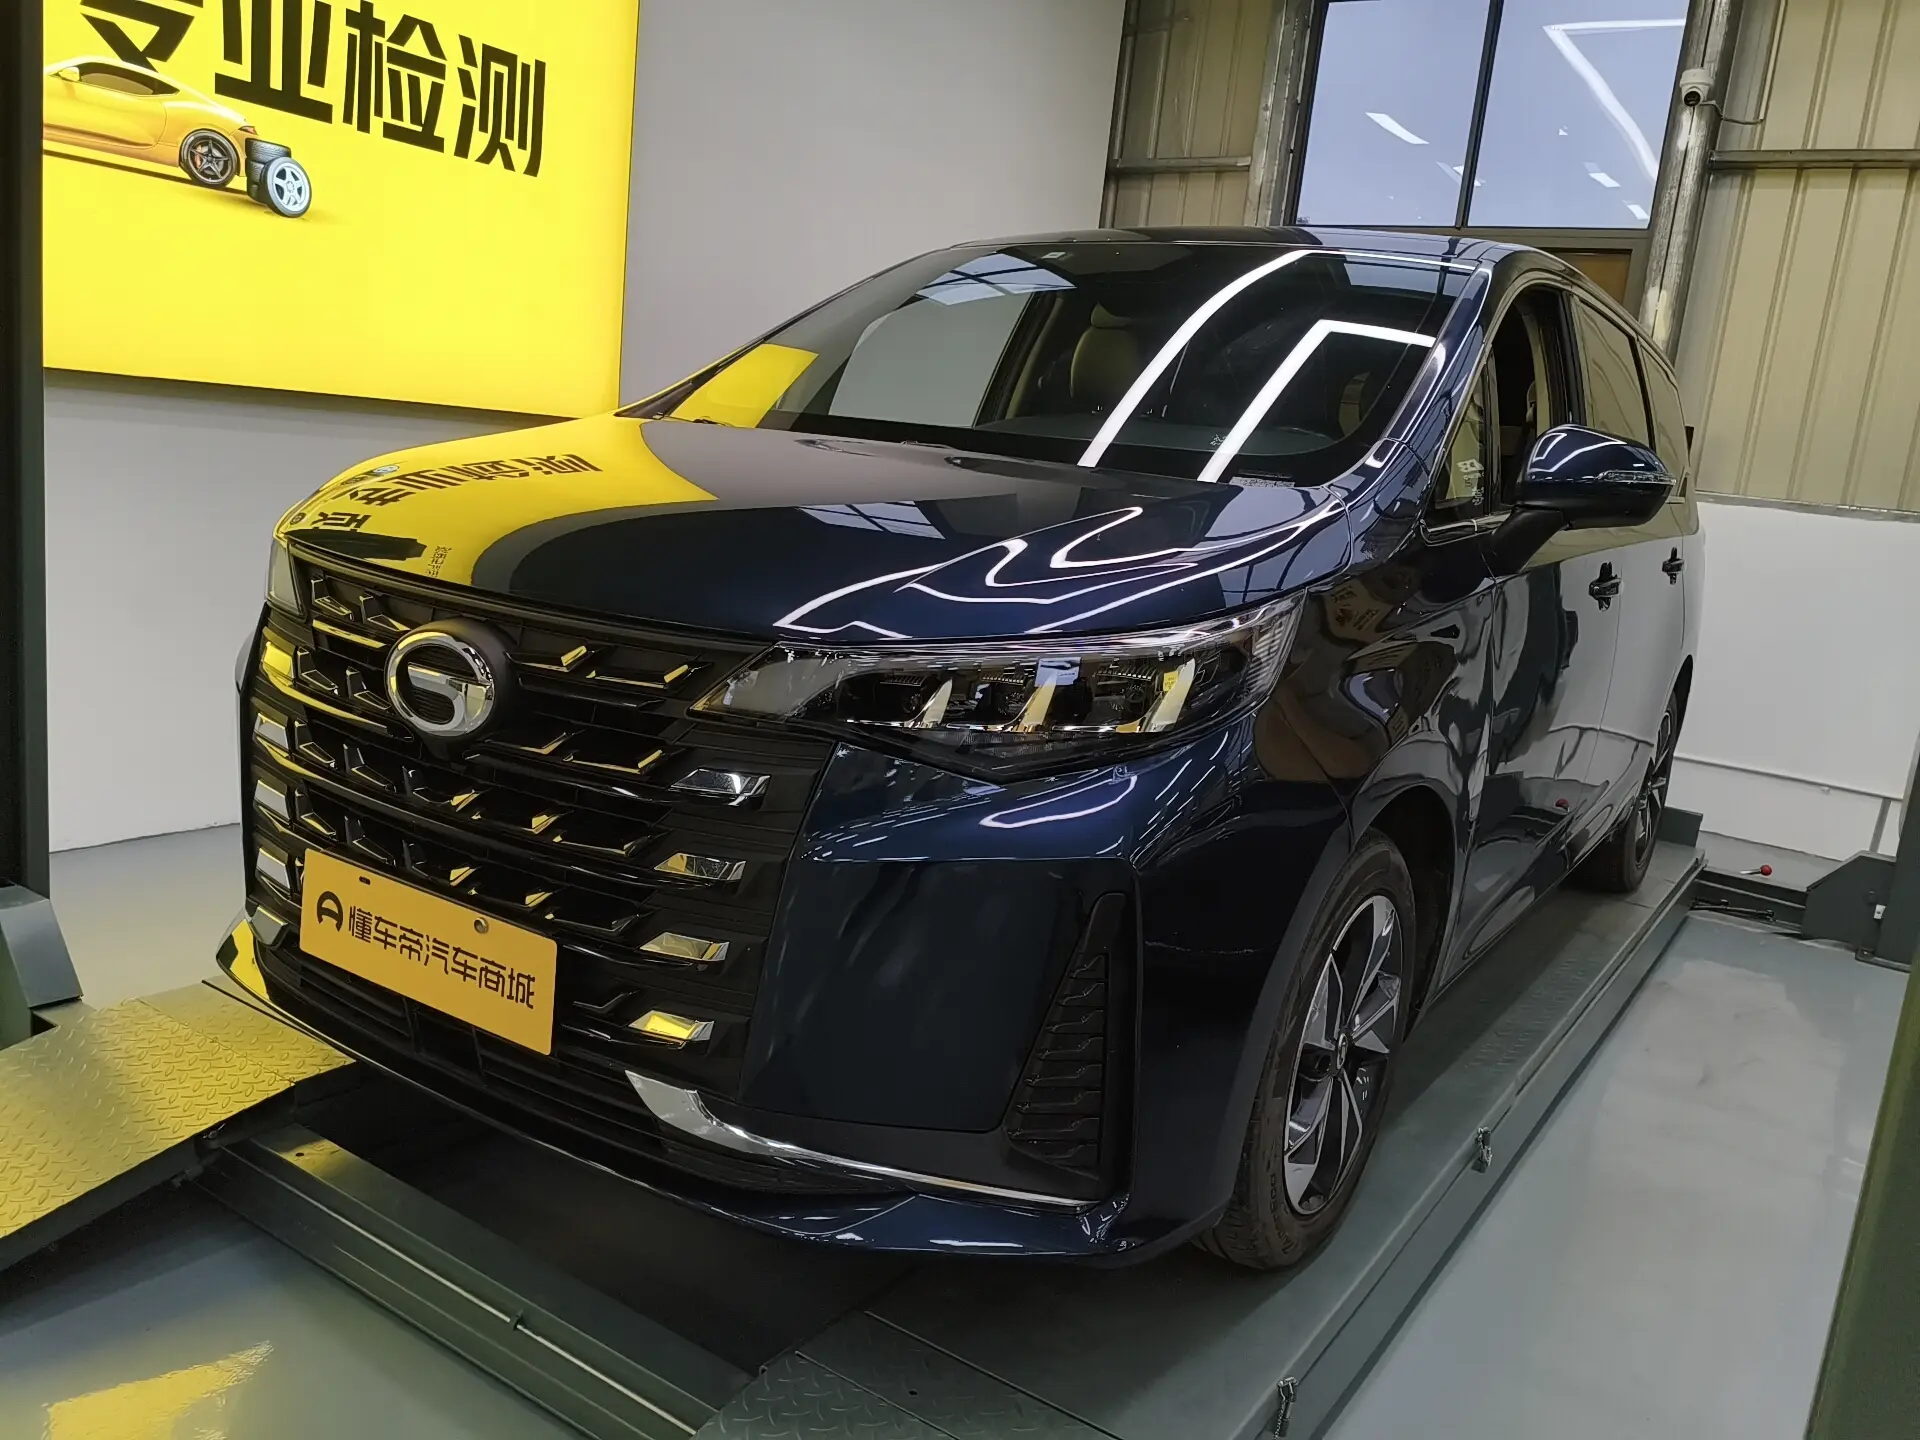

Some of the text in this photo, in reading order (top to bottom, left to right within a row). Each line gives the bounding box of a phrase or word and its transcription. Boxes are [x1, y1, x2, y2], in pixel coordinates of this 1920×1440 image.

[348, 905, 536, 1010] 懂车帝汽车商城
